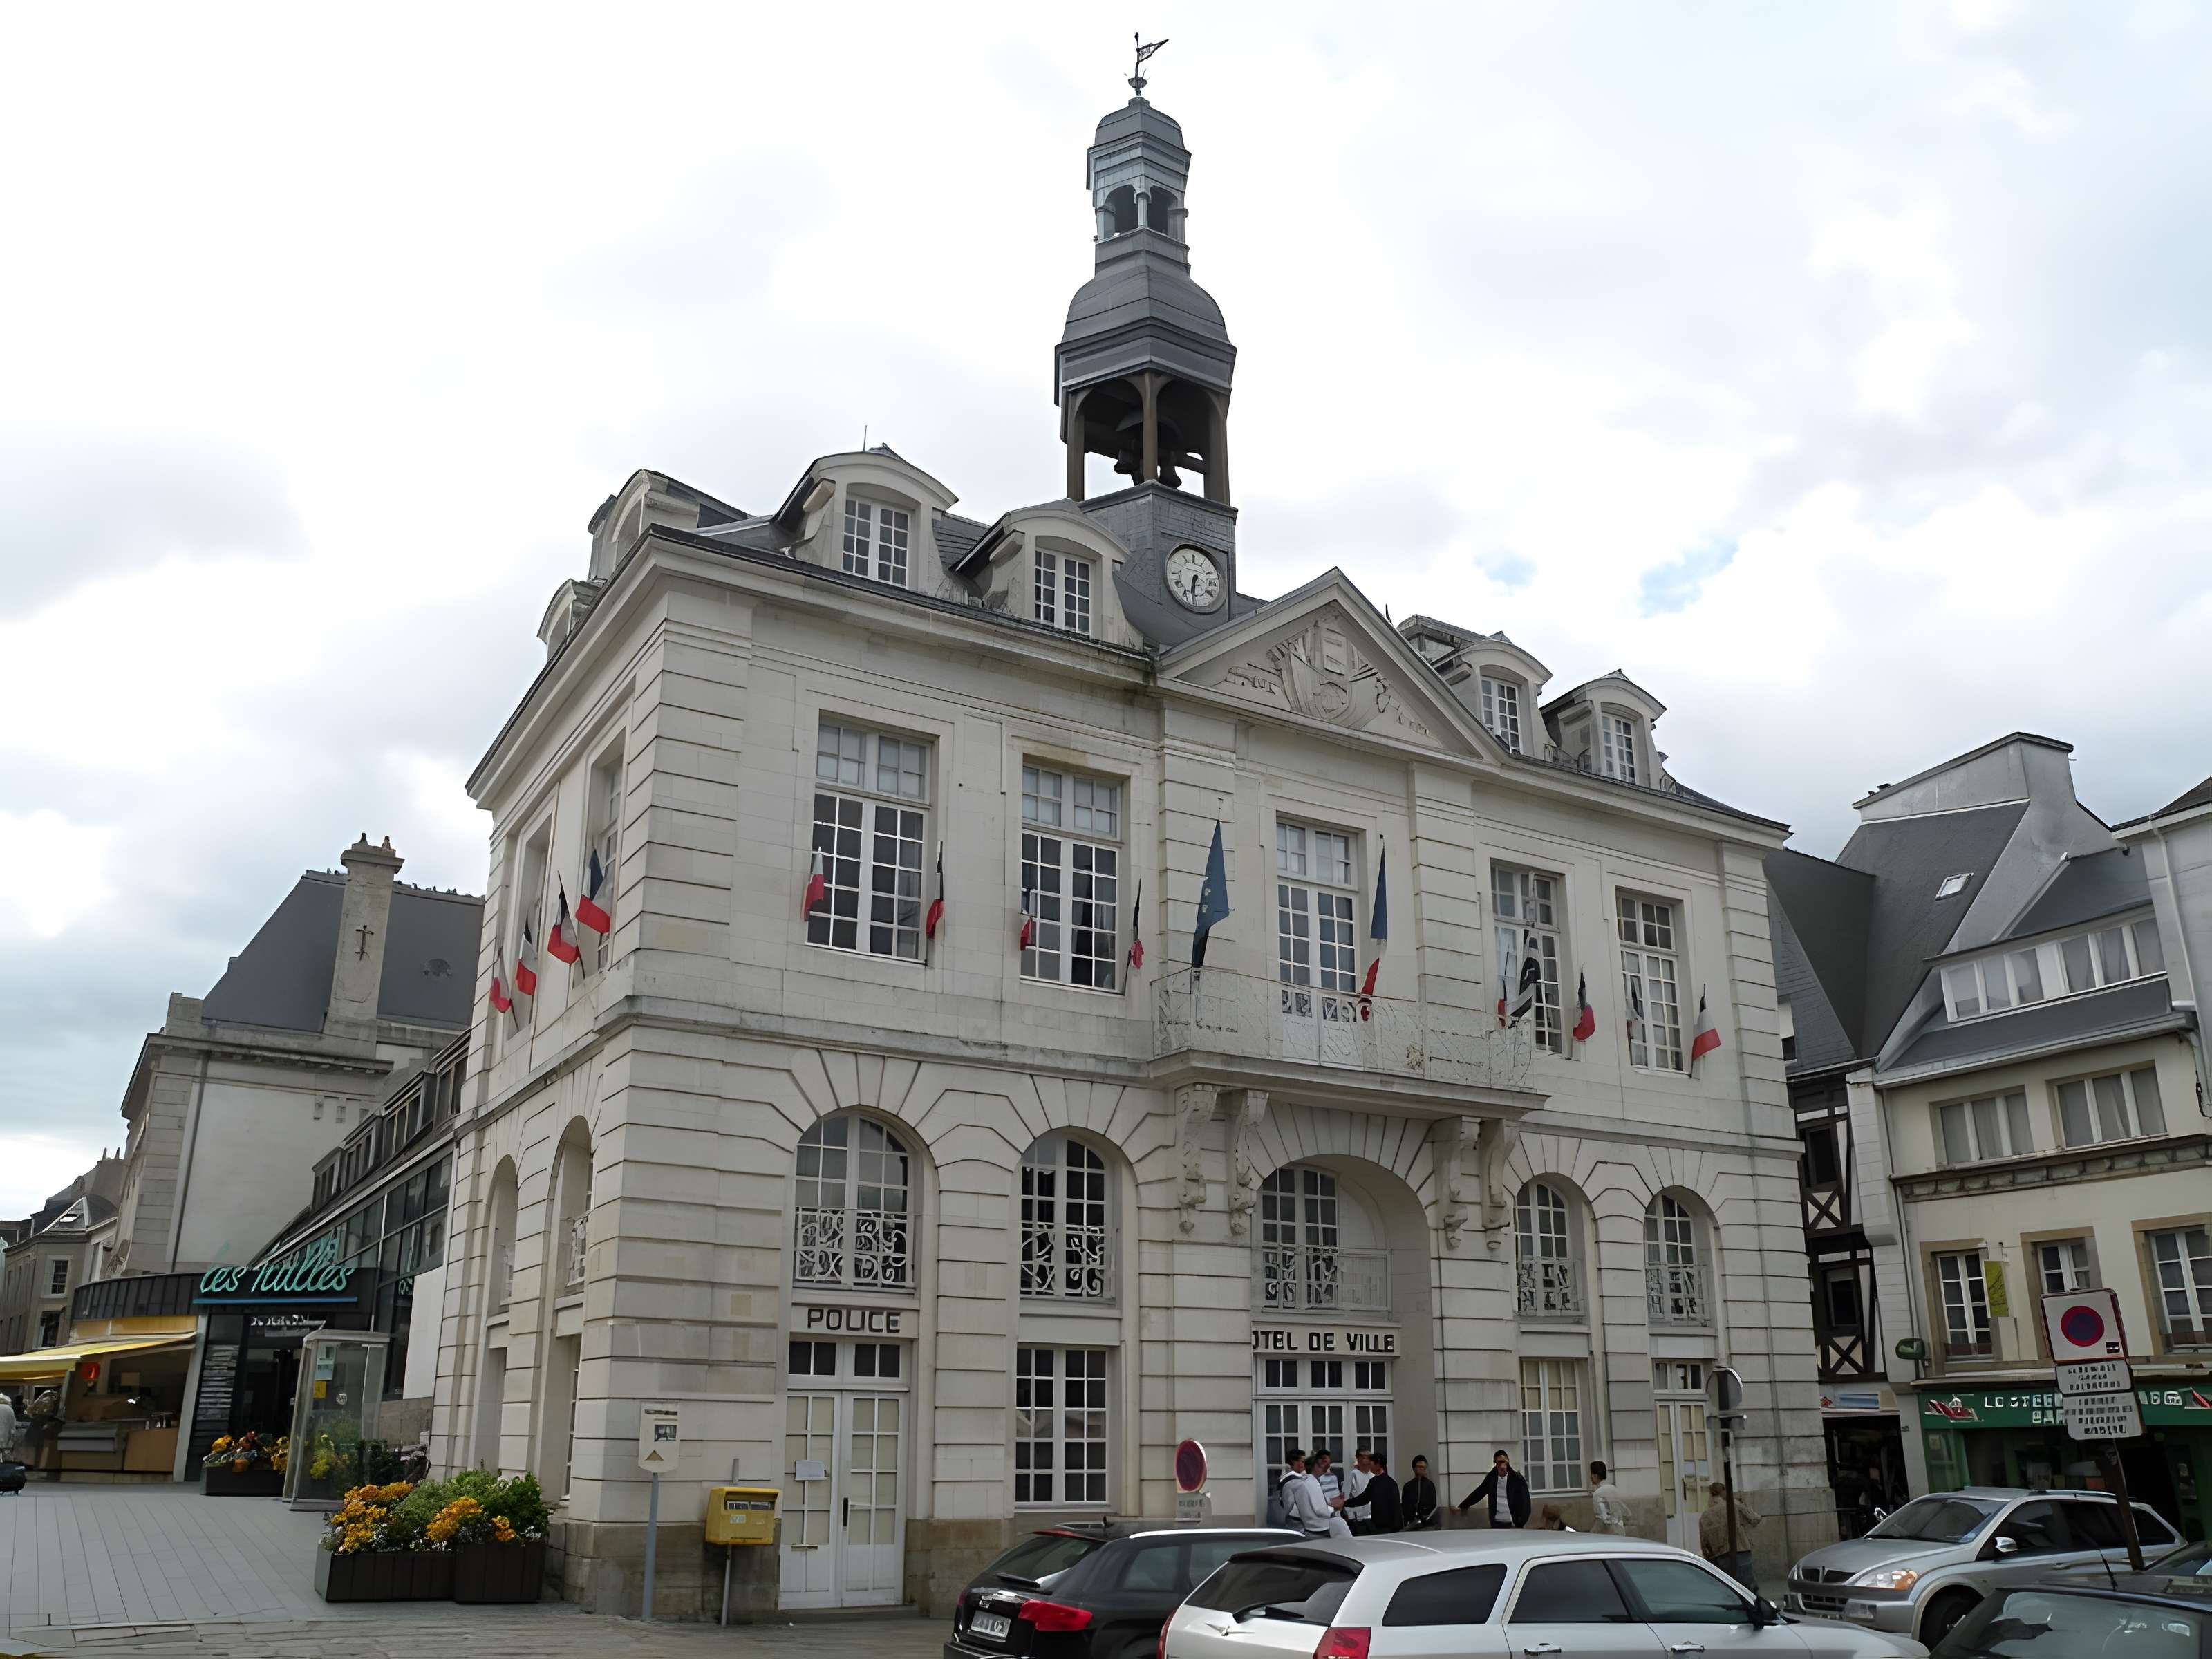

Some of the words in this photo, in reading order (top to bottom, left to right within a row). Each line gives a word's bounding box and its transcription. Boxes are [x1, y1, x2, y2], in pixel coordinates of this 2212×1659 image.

[807, 1308, 901, 1333] POLICE
[1309, 1332, 1335, 1351] DE
[1347, 1333, 1395, 1353] VILLE
